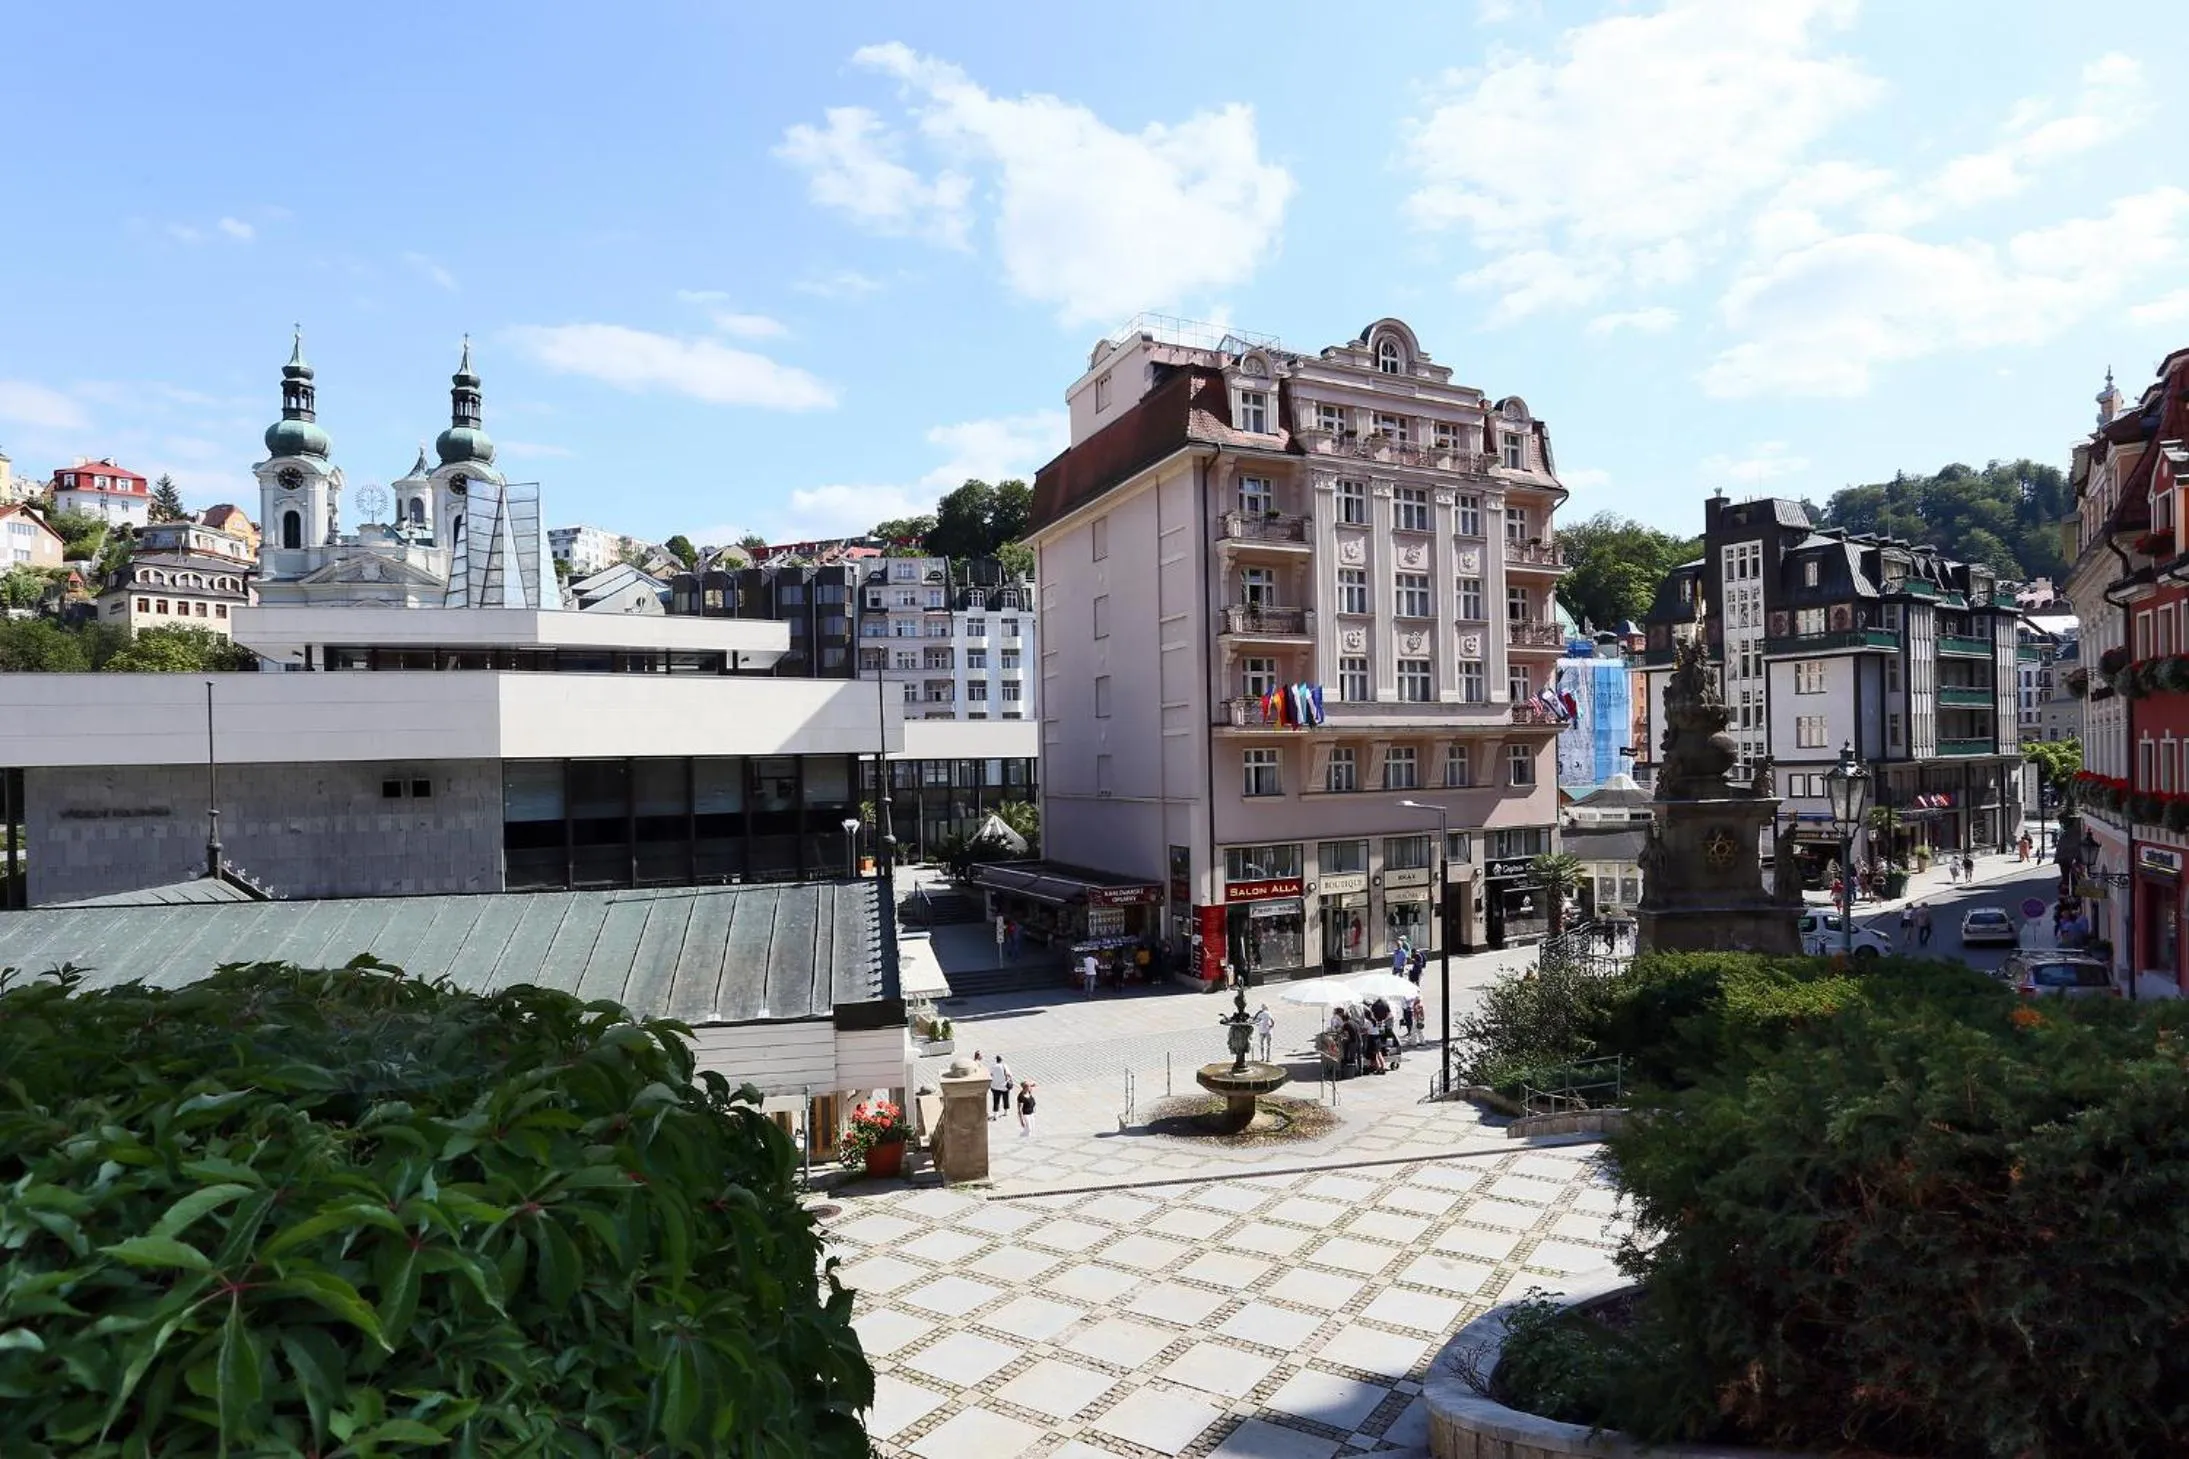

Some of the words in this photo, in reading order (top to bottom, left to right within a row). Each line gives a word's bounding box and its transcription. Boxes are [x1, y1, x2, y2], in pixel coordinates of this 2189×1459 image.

[1324, 878, 1362, 889] BOUTIQUE
[1230, 887, 1267, 897] SALON
[1271, 884, 1299, 893] ALLA
